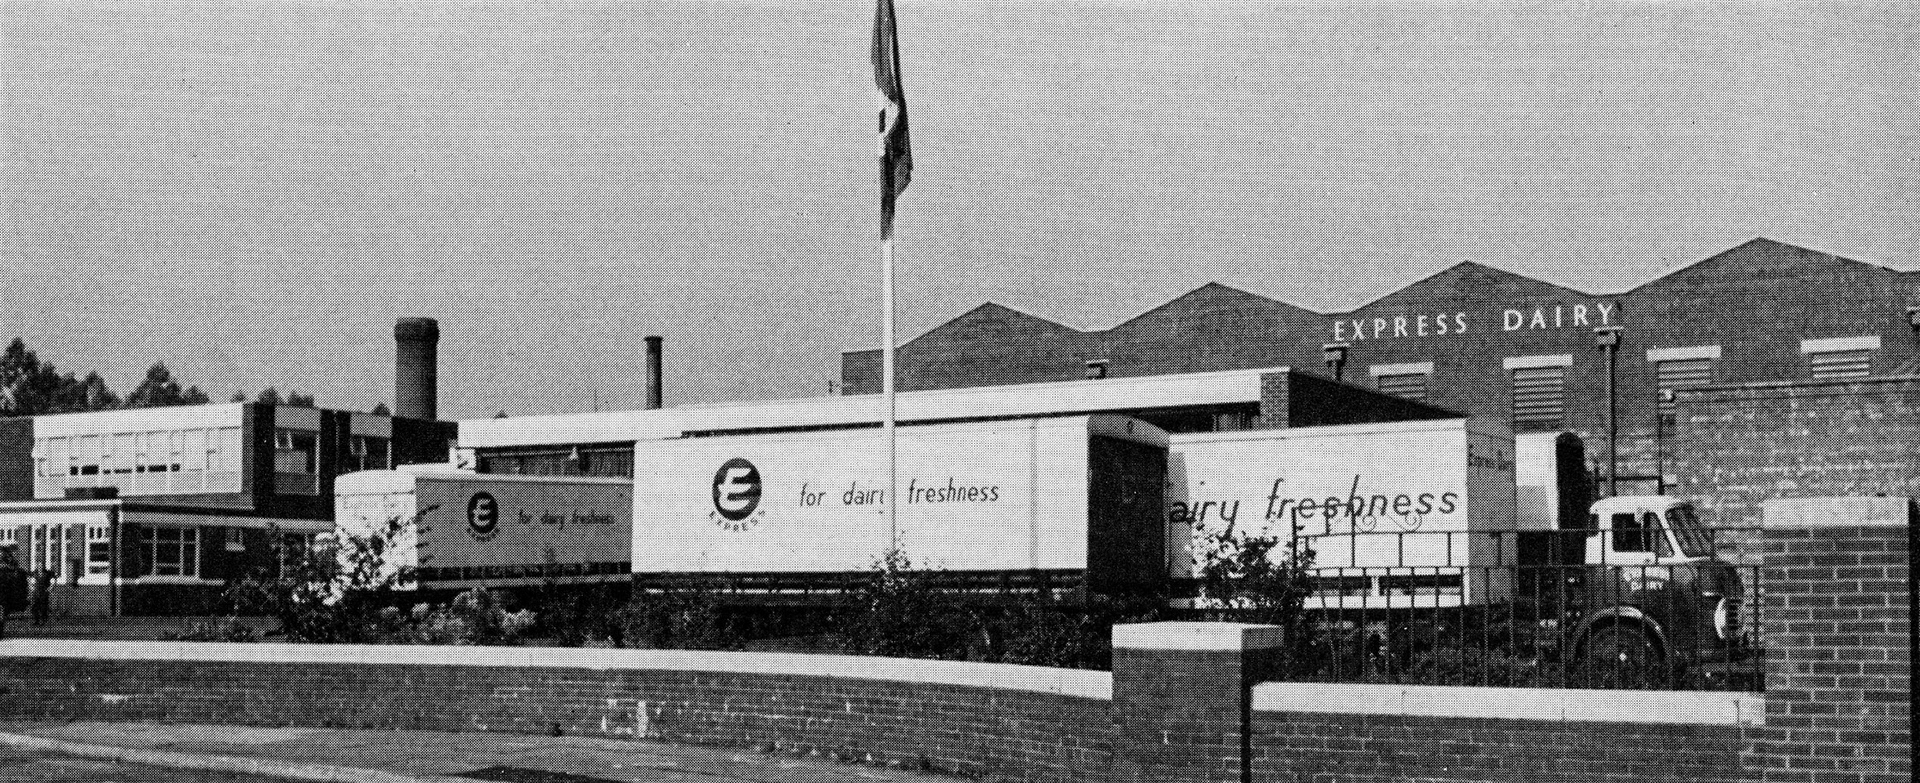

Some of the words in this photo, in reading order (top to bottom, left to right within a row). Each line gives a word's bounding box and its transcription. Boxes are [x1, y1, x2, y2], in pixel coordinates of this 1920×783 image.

[1333, 312, 1467, 342] EXPRESS
[1503, 303, 1613, 332] DAIRY
[799, 482, 827, 507] for
[908, 477, 999, 504] freshness
[1169, 501, 1239, 540] airy
[1265, 474, 1459, 519] freshness
[708, 510, 766, 533] EXPRESS
